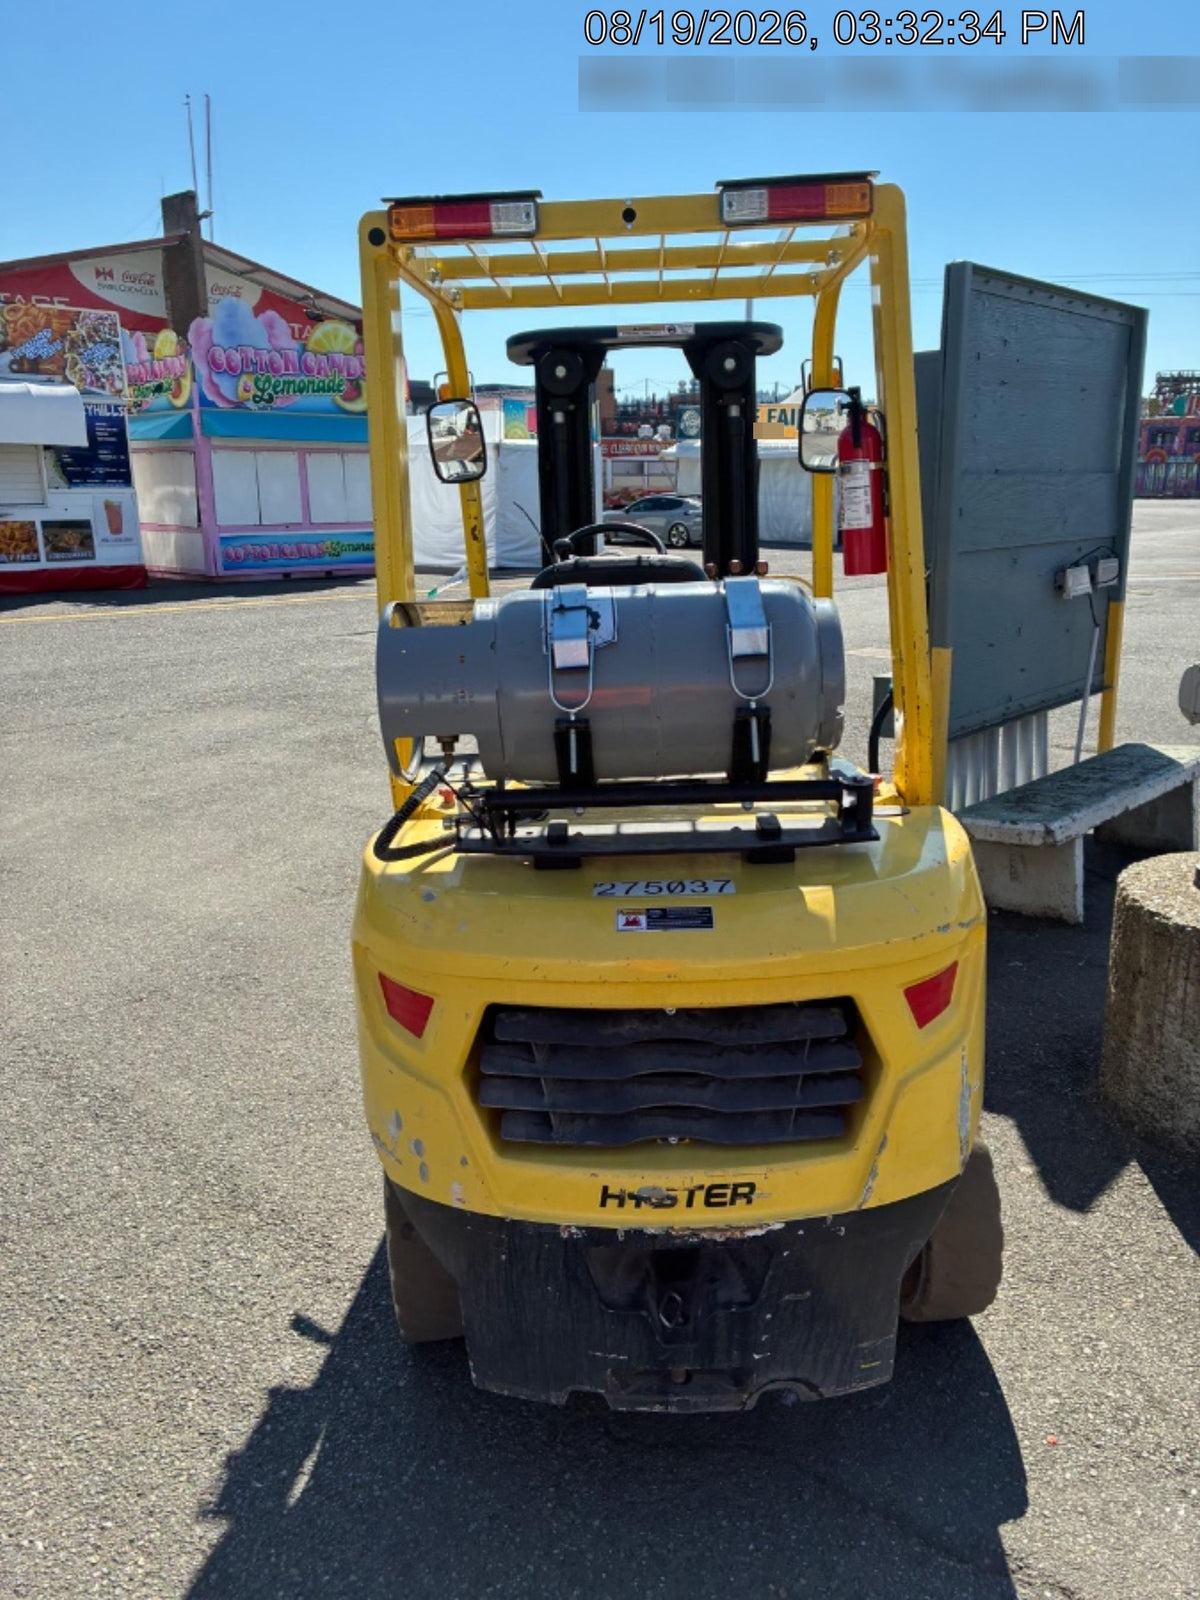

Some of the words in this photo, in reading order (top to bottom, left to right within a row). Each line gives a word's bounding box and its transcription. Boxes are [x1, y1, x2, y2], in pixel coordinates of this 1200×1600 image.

[208, 346, 299, 376] COTTON
[252, 368, 346, 404] Lemonade
[767, 408, 797, 427] FAI
[594, 879, 732, 897] 275037
